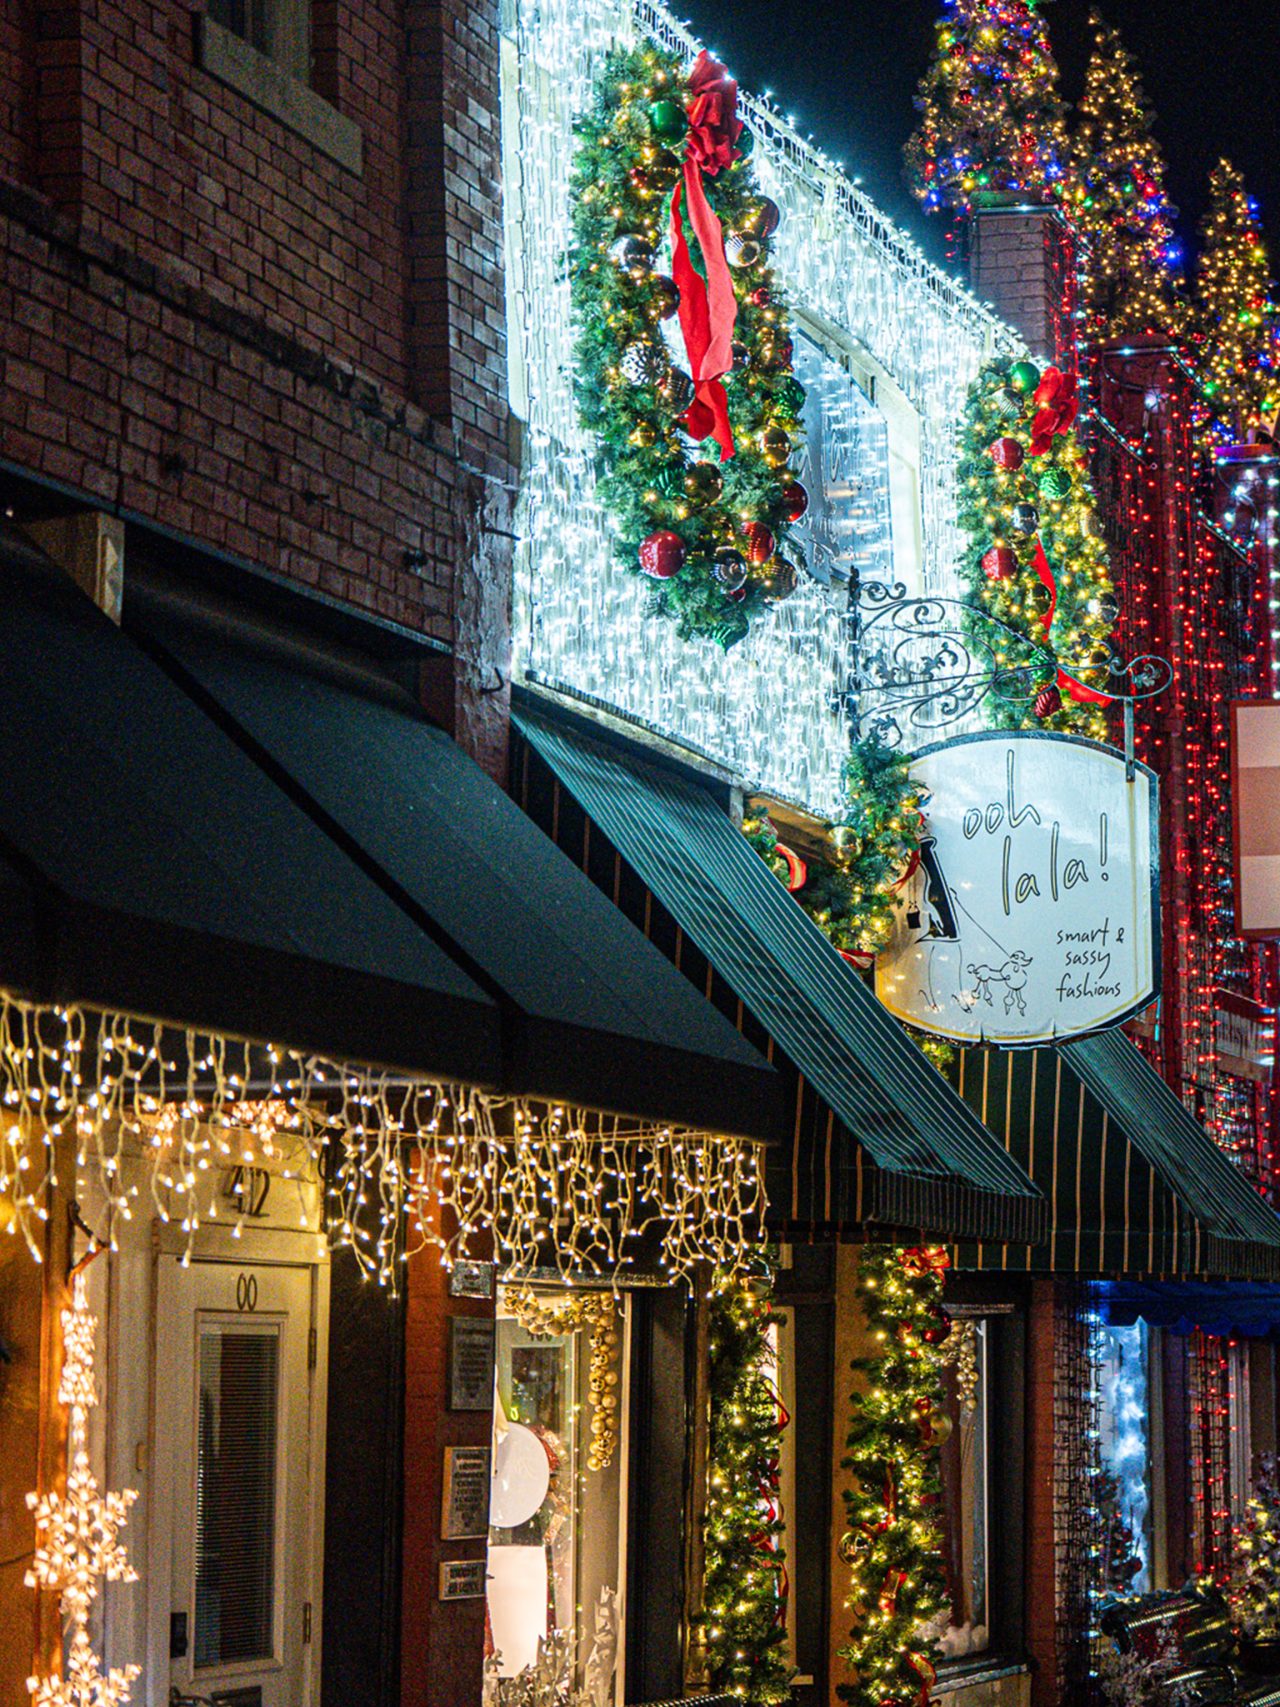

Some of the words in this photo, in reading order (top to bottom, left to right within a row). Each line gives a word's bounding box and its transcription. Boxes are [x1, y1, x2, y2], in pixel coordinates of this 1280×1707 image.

[963, 749, 1041, 839] ooh
[1056, 917, 1110, 944] smart
[1115, 928, 1126, 943] &
[1065, 951, 1111, 980] sassy
[1056, 974, 1122, 999] fashions
